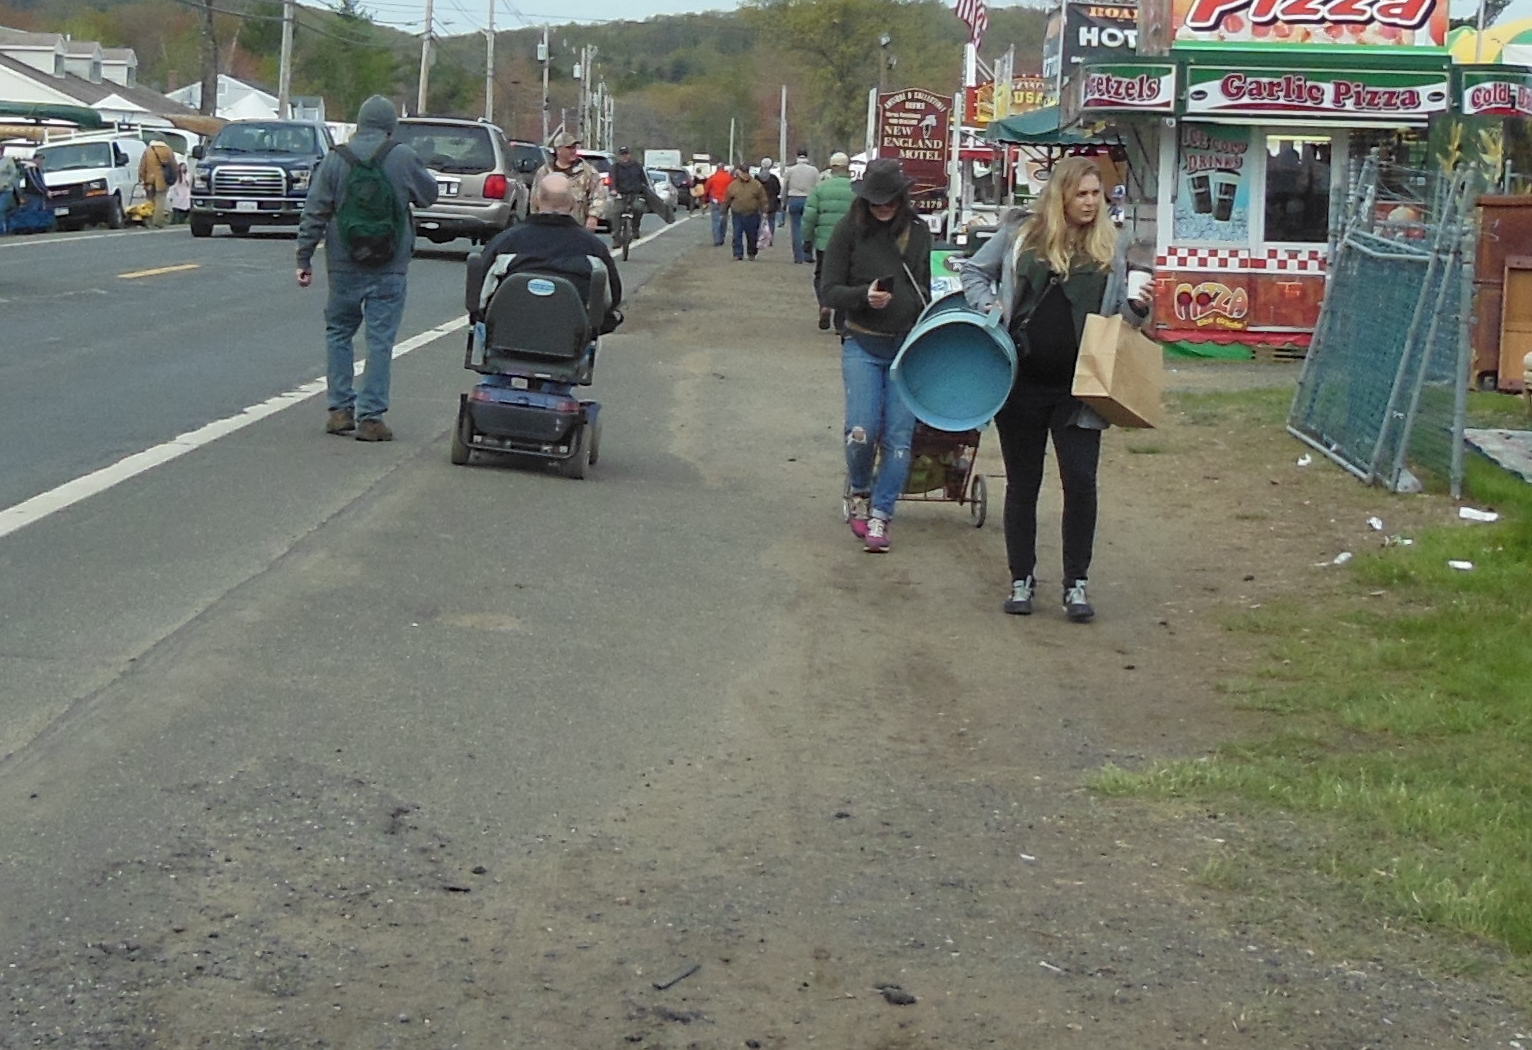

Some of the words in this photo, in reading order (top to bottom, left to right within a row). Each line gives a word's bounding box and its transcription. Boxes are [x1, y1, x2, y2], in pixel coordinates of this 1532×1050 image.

[1088, 7, 1138, 19] ROA
[1013, 91, 1045, 104] USA
[1220, 74, 1325, 103] Garlic
[1331, 80, 1422, 110] Pizza
[1471, 83, 1511, 109] Cold
[883, 125, 914, 136] NEW
[883, 137, 943, 149] ENGLAND
[898, 150, 943, 161] MOTEL
[1187, 154, 1243, 172] DRINKS
